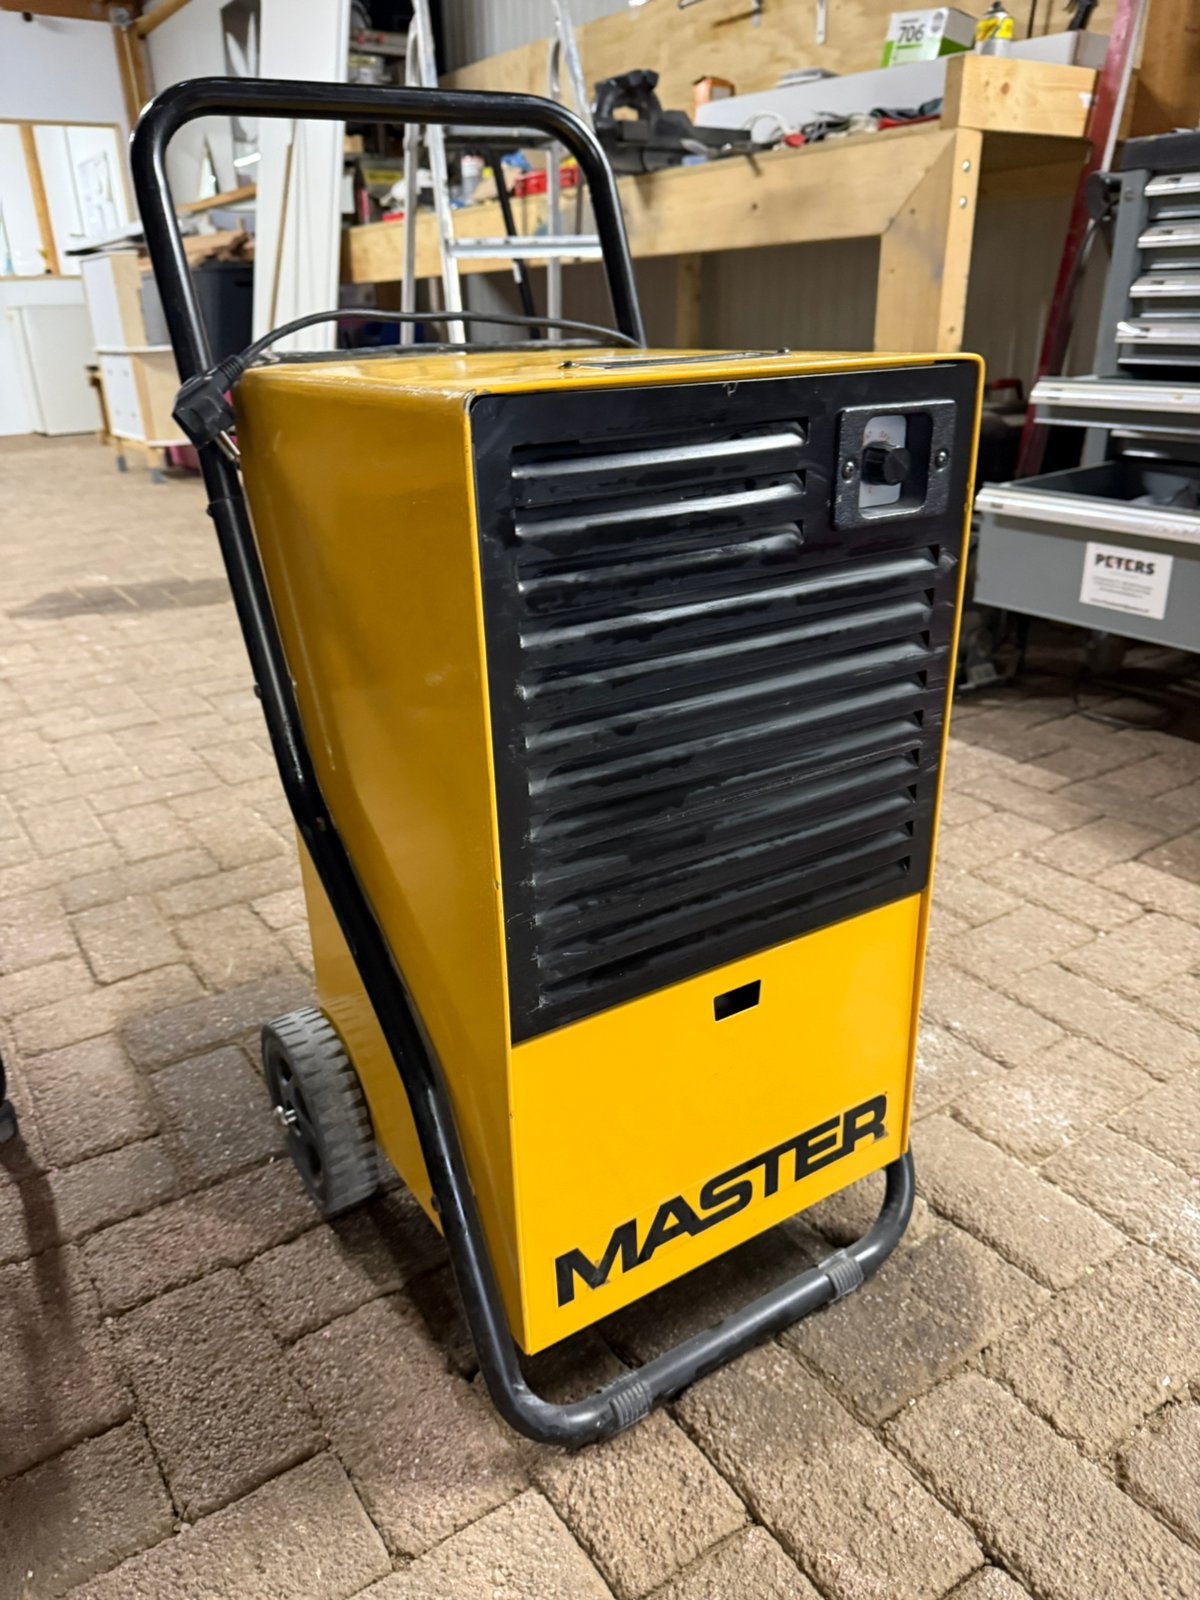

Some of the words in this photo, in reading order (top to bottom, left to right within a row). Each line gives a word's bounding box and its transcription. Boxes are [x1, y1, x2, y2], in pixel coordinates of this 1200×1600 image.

[898, 24, 926, 44] 706
[1094, 553, 1155, 575] PETERS
[555, 1094, 887, 1308] MASTER
